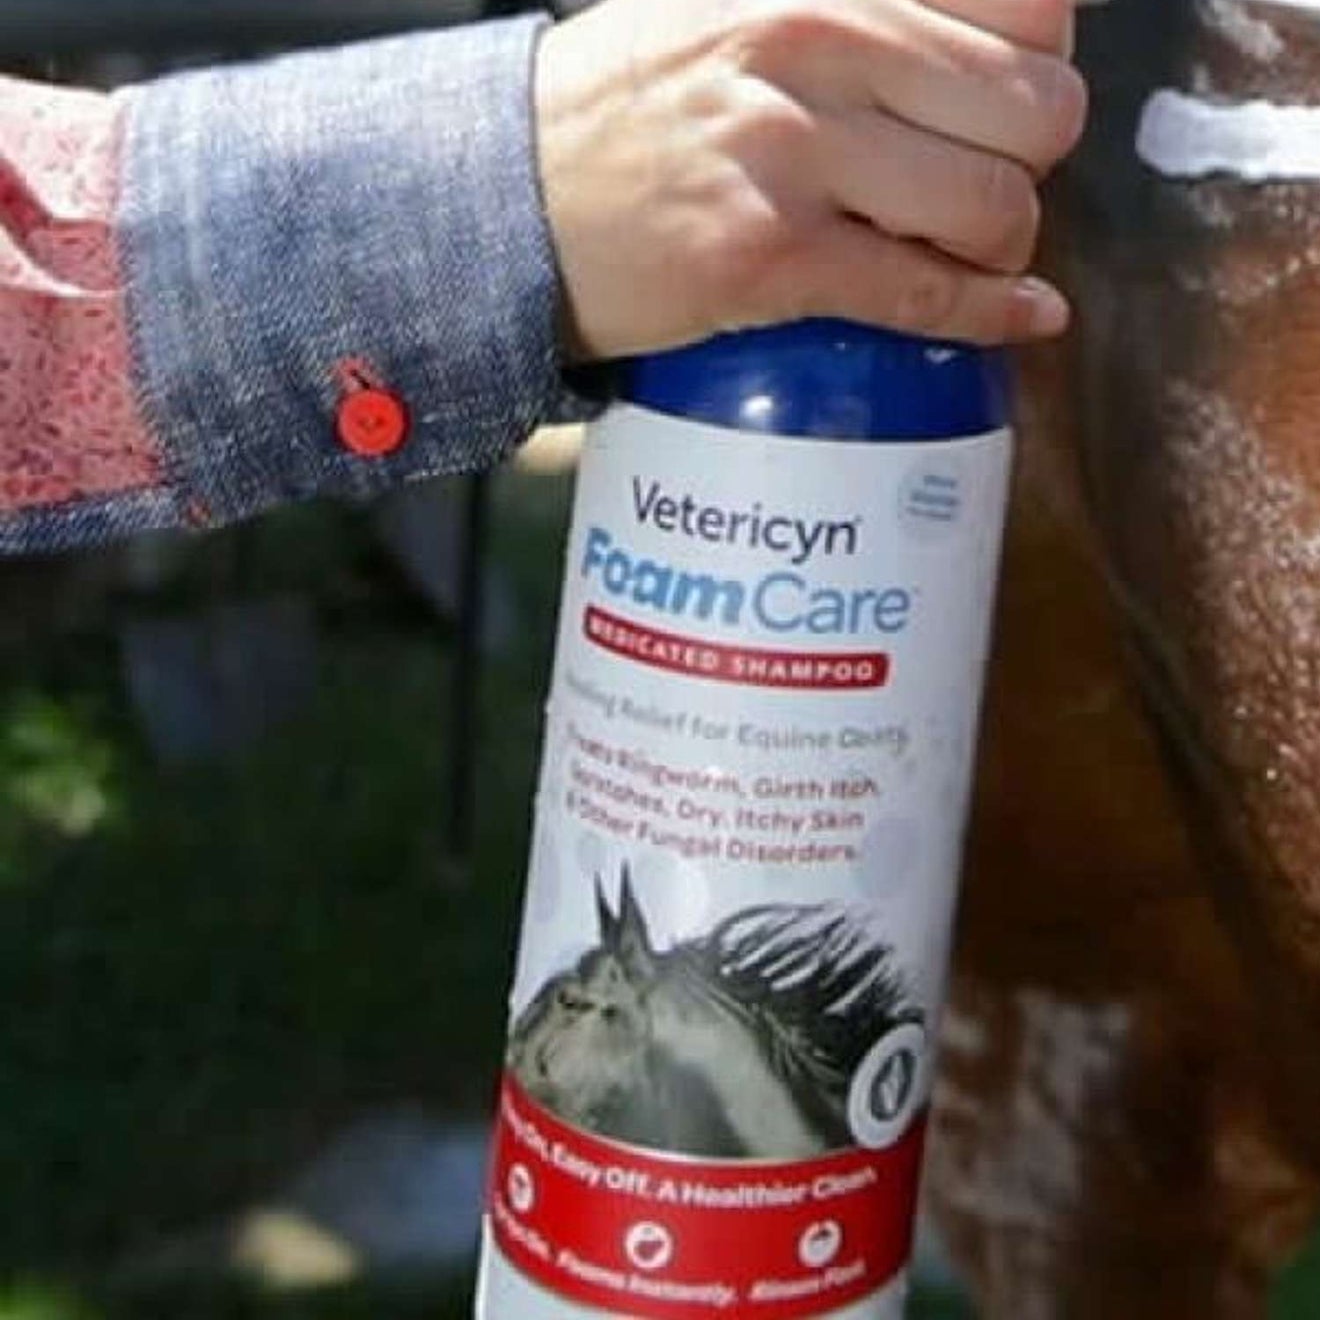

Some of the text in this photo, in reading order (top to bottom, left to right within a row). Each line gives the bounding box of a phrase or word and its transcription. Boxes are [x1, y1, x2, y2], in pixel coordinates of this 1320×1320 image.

[632, 476, 857, 563] Vetericyn
[589, 615, 874, 682] MEDICATED SHAMPOO
